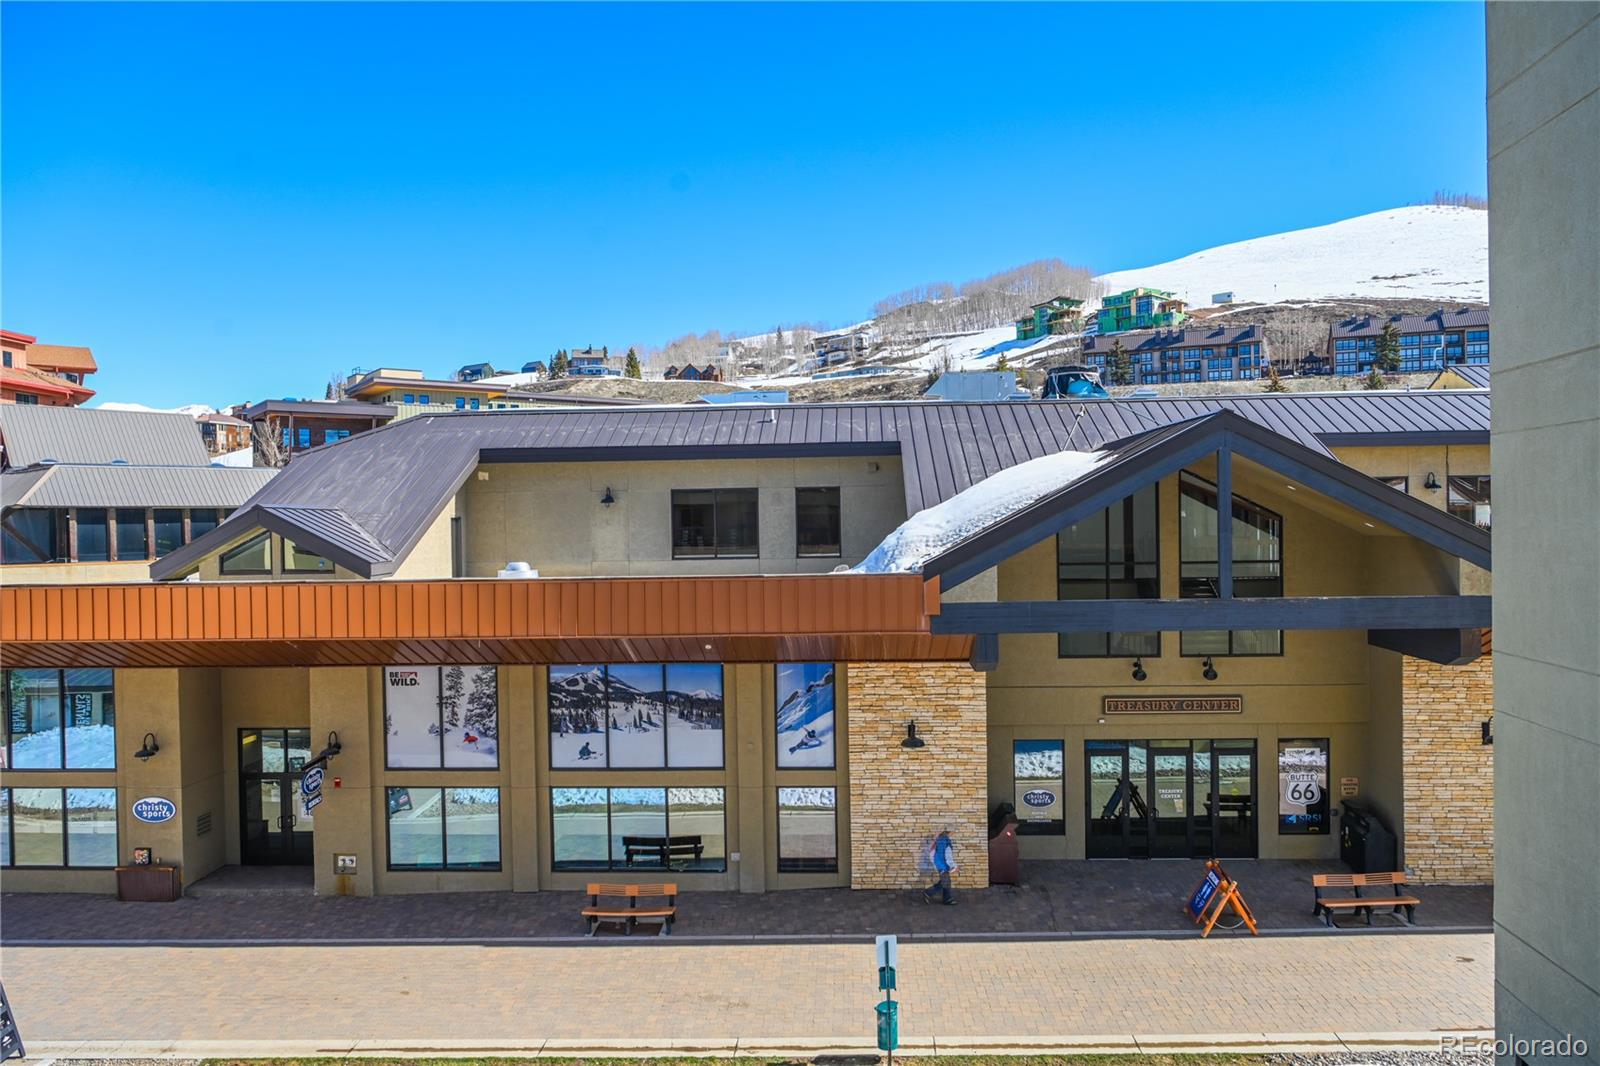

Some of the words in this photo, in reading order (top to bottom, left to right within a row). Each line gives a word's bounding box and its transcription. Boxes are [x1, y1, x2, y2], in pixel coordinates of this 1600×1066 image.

[1108, 701, 1179, 711] TREASURY
[1183, 700, 1239, 710] CENTER
[1026, 793, 1050, 801] christy
[1291, 783, 1315, 801] 66
[137, 803, 168, 813] christy
[142, 809, 171, 819] sports
